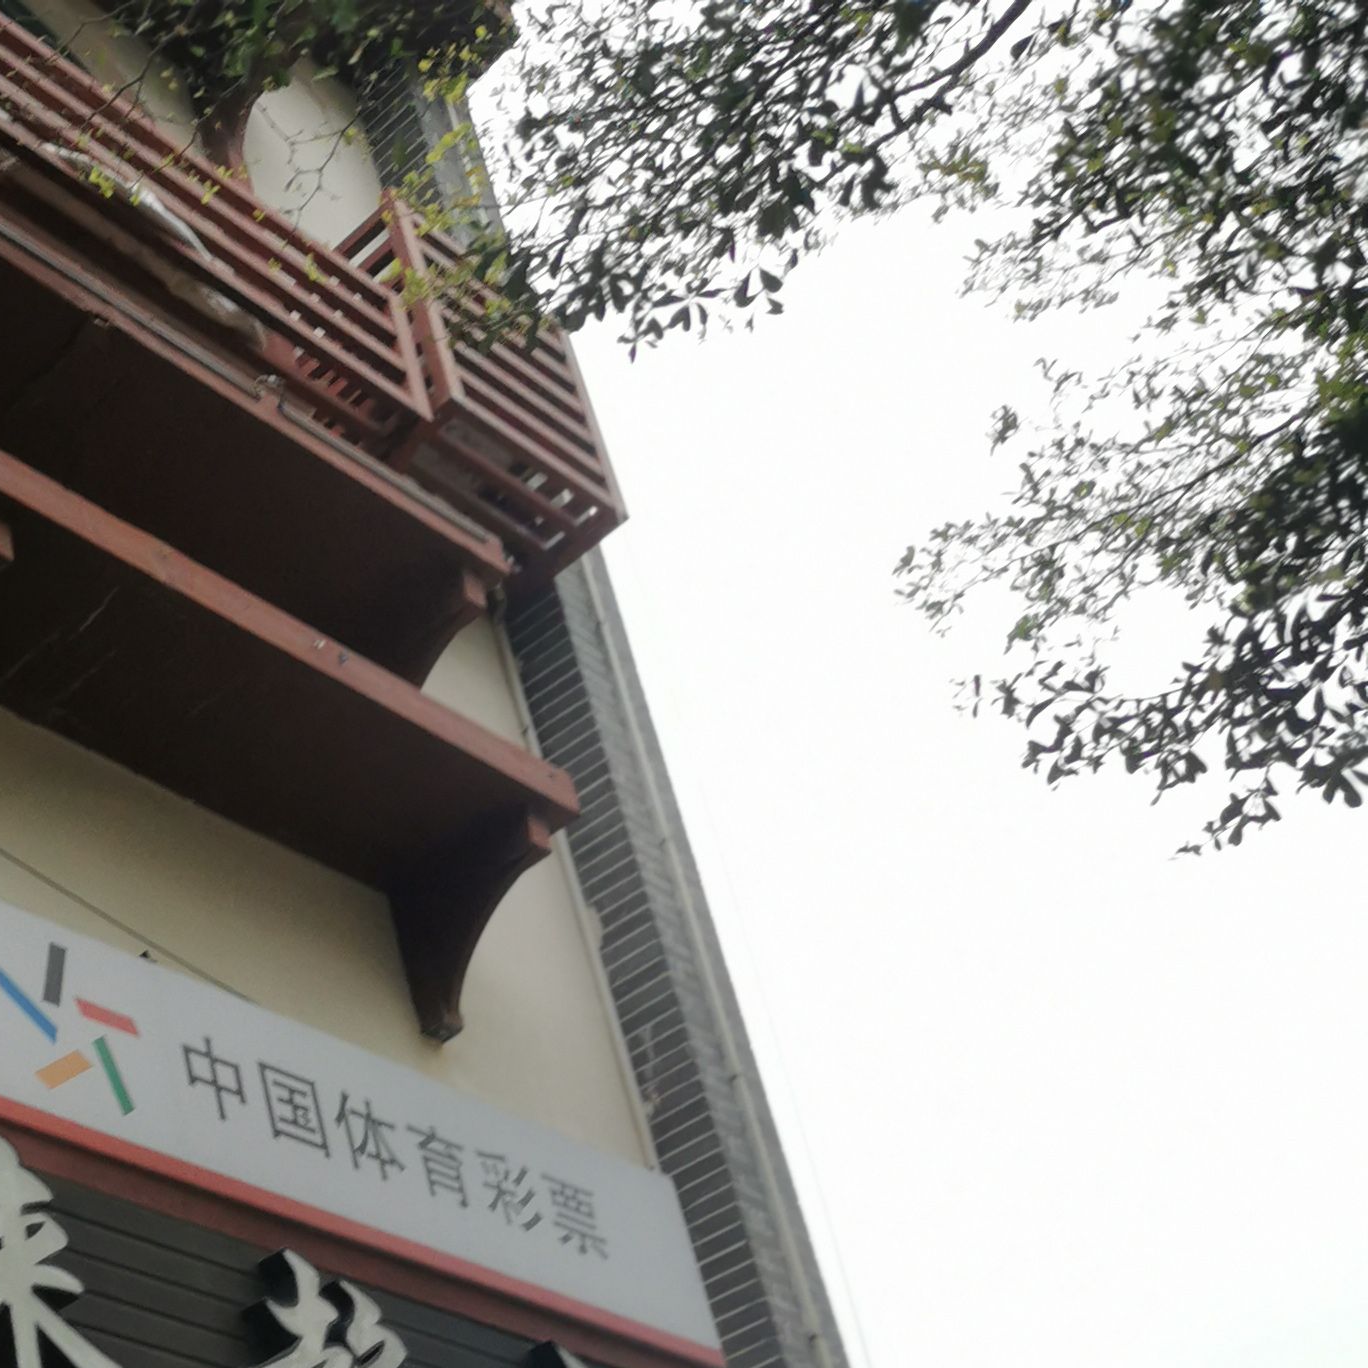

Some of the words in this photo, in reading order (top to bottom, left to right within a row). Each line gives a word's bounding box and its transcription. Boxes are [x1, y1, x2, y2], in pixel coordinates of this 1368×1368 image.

[182, 1036, 610, 1262] 中国体育彩票
